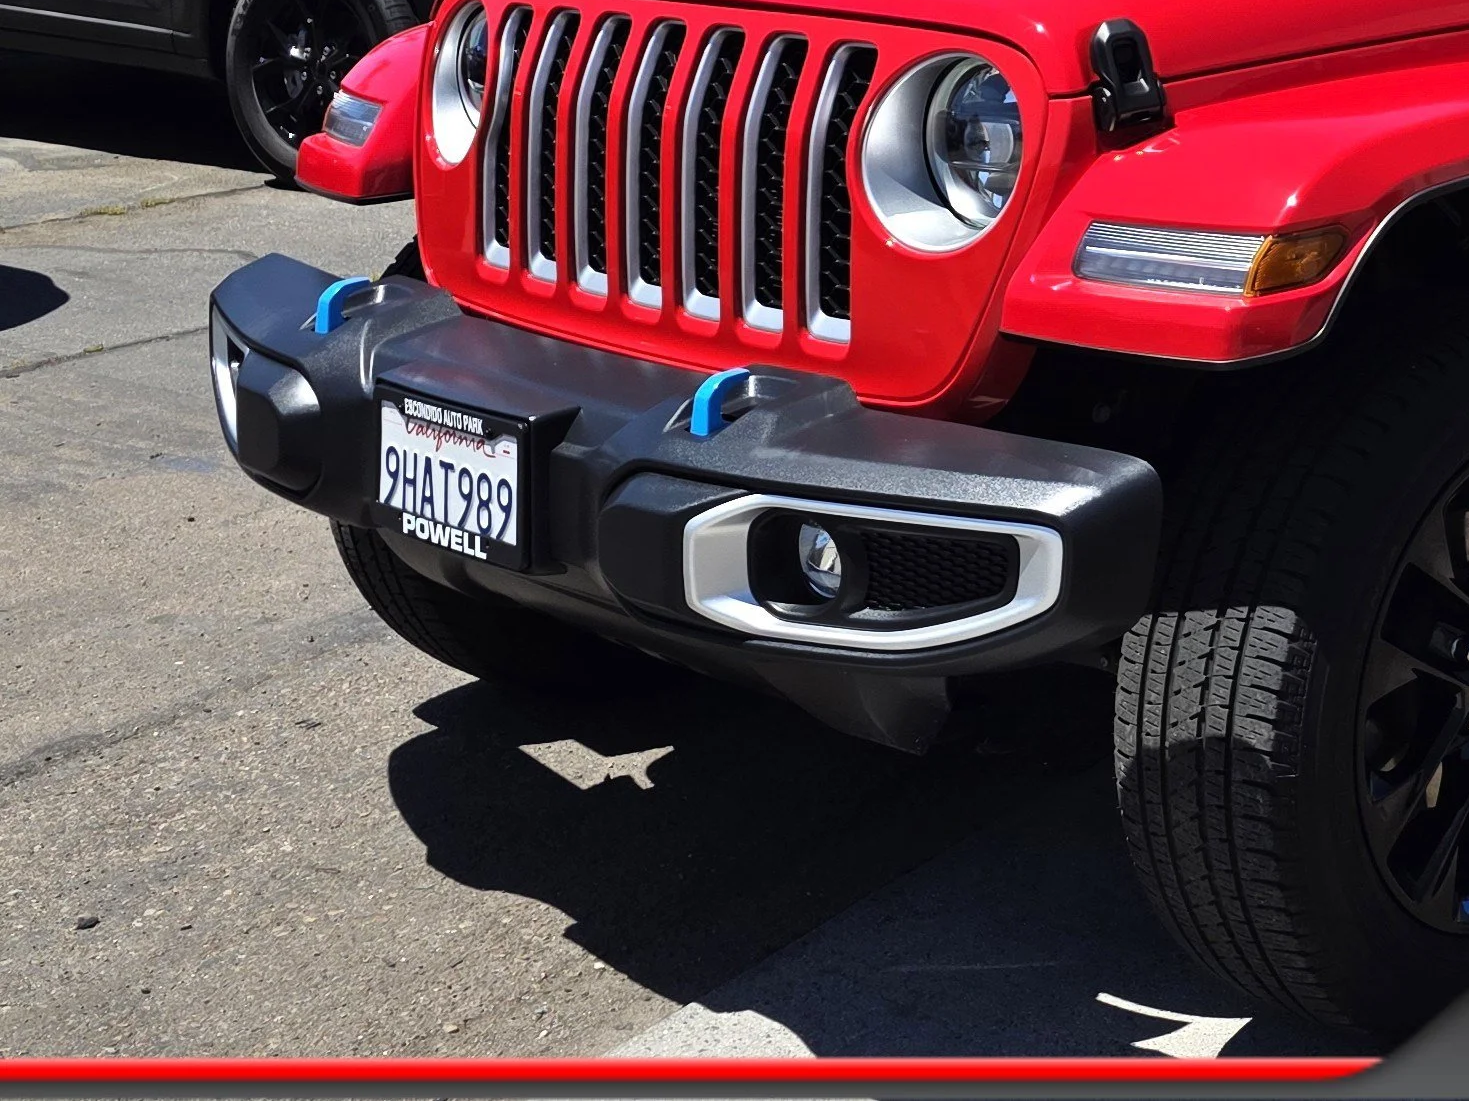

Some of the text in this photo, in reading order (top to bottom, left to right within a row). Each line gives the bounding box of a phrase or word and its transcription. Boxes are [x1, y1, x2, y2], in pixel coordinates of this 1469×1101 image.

[404, 397, 484, 436] ESCONDIDO AUTO PARK
[406, 417, 496, 459] California
[383, 445, 513, 540] 9HAT989
[402, 511, 488, 560] POWELL
